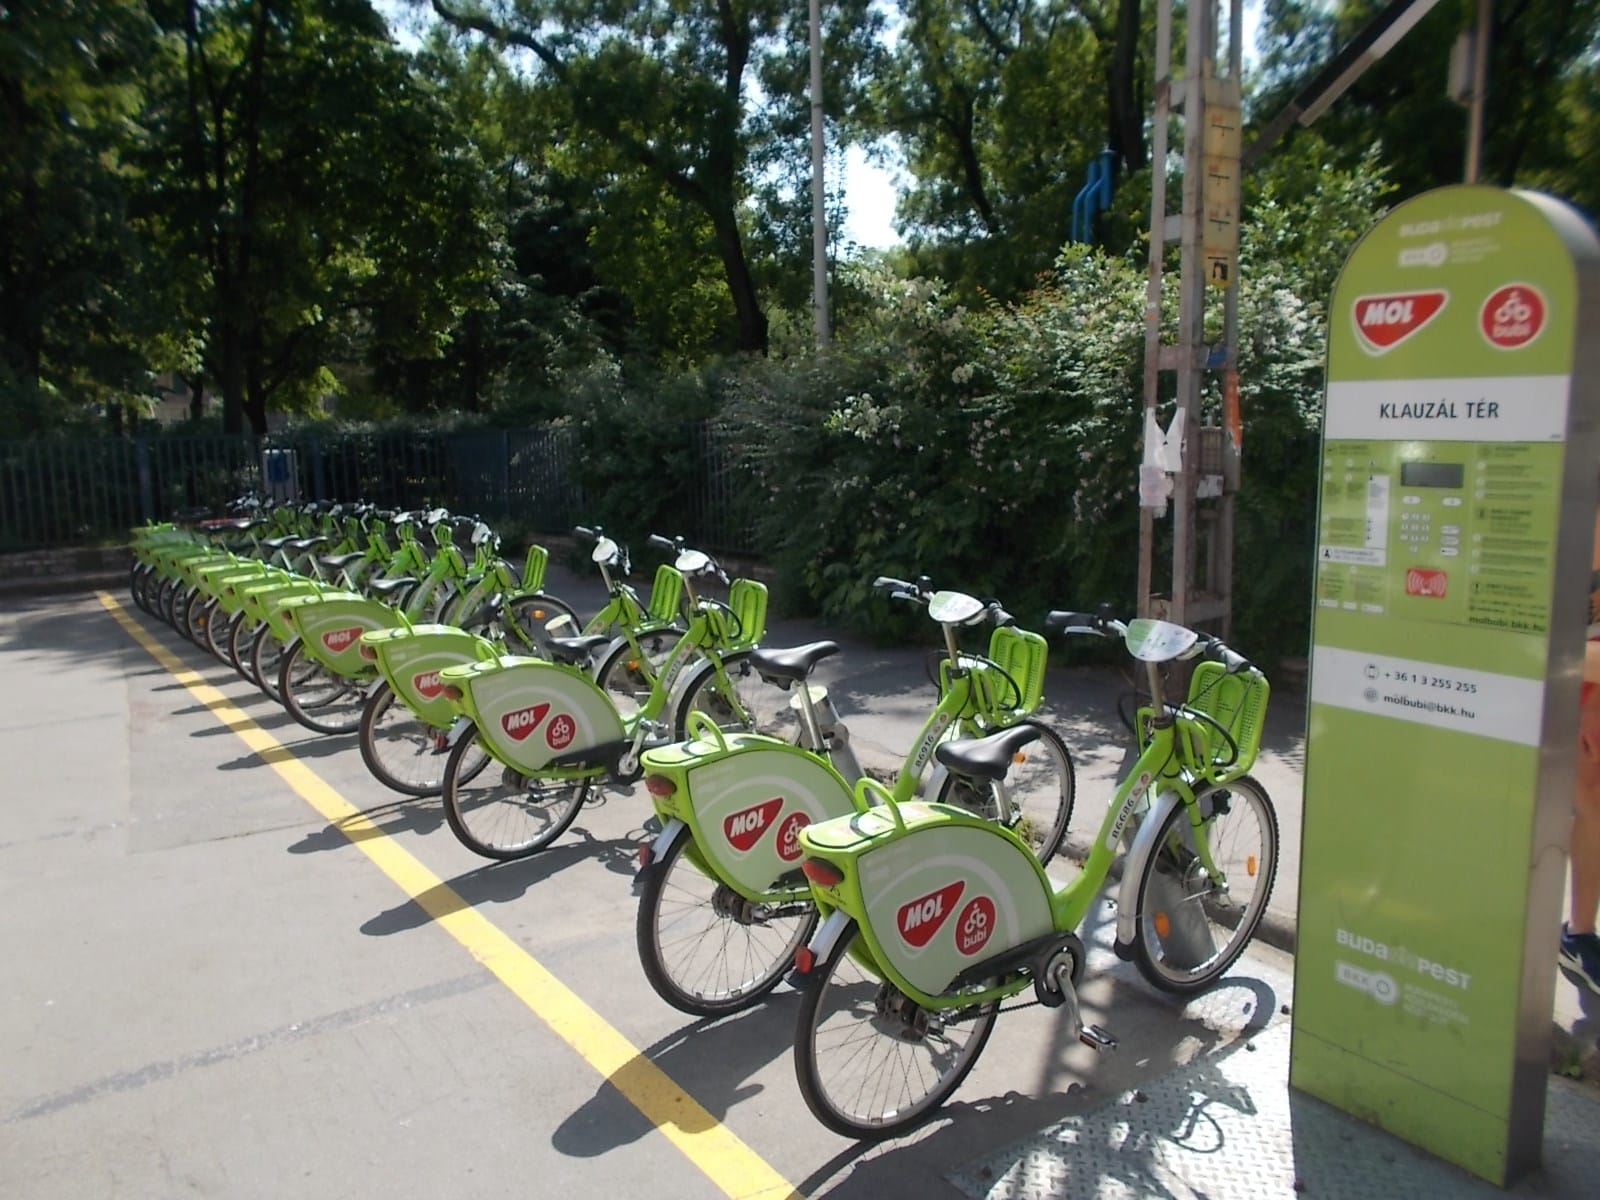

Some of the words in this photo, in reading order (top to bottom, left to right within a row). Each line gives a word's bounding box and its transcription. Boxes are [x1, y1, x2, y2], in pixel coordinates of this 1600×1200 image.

[1362, 300, 1414, 326] MOL
[1379, 399, 1458, 419] KLAUZÁL
[1466, 398, 1500, 419] TÉR
[327, 631, 350, 645] MOL
[419, 674, 440, 689] MO
[1394, 671, 1408, 682] 36
[1412, 674, 1417, 684] 1
[1421, 675, 1428, 685] 3
[1431, 677, 1452, 690] 255
[1456, 681, 1478, 694] 255
[506, 710, 536, 732] MOL
[730, 808, 765, 838] MOL
[784, 842, 802, 856] bub
[903, 894, 944, 932] MOL
[963, 931, 987, 949] bubi
